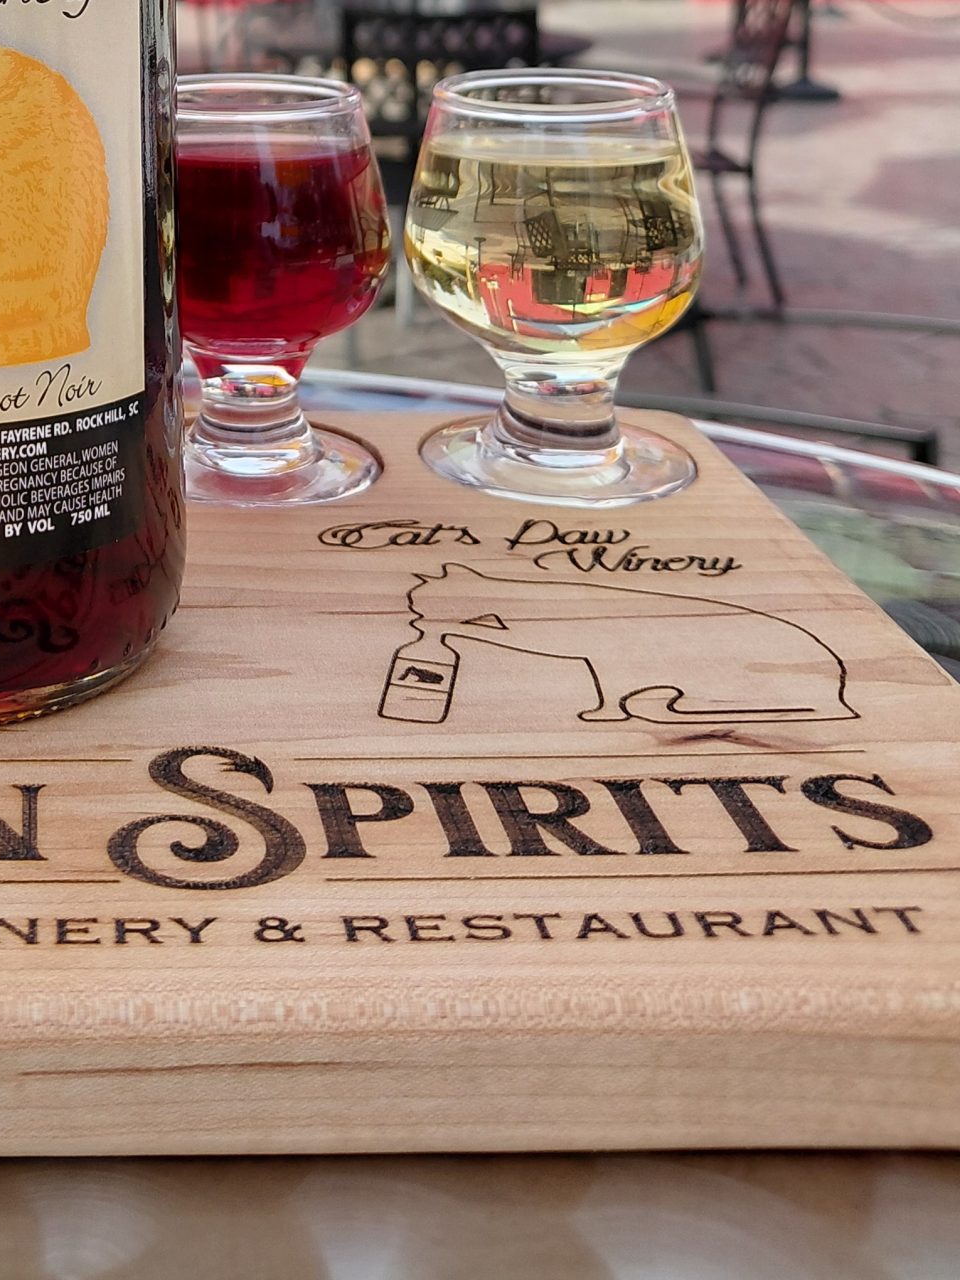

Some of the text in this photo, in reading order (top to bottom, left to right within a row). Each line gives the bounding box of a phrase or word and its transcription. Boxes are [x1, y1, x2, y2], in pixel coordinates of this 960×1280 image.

[34, 363, 102, 408] Noir
[0, 424, 52, 444] FAYRENE
[54, 421, 72, 436] RD.
[76, 413, 103, 432] ROCK
[105, 407, 126, 424] HILL,
[128, 401, 139, 416] SC
[30, 451, 81, 472] GENERAL,
[82, 440, 118, 461] WOMEN
[60, 460, 104, 483] BECAUSE
[105, 456, 118, 471] OF
[27, 502, 52, 520] MAY
[53, 495, 87, 515] CAUSE
[88, 484, 123, 506] HEALTH
[30, 479, 90, 504] BEVERAGES
[91, 467, 125, 489] IMPAIRS
[4, 522, 23, 538] BY
[27, 517, 55, 534] VOL
[71, 509, 92, 526] 750
[93, 503, 111, 520] ML
[318, 518, 631, 550] Cat's Paw
[533, 545, 743, 577] Winery
[107, 746, 934, 891] SPIRITS
[253, 914, 306, 943] &
[344, 905, 924, 942] RESTAURANT
